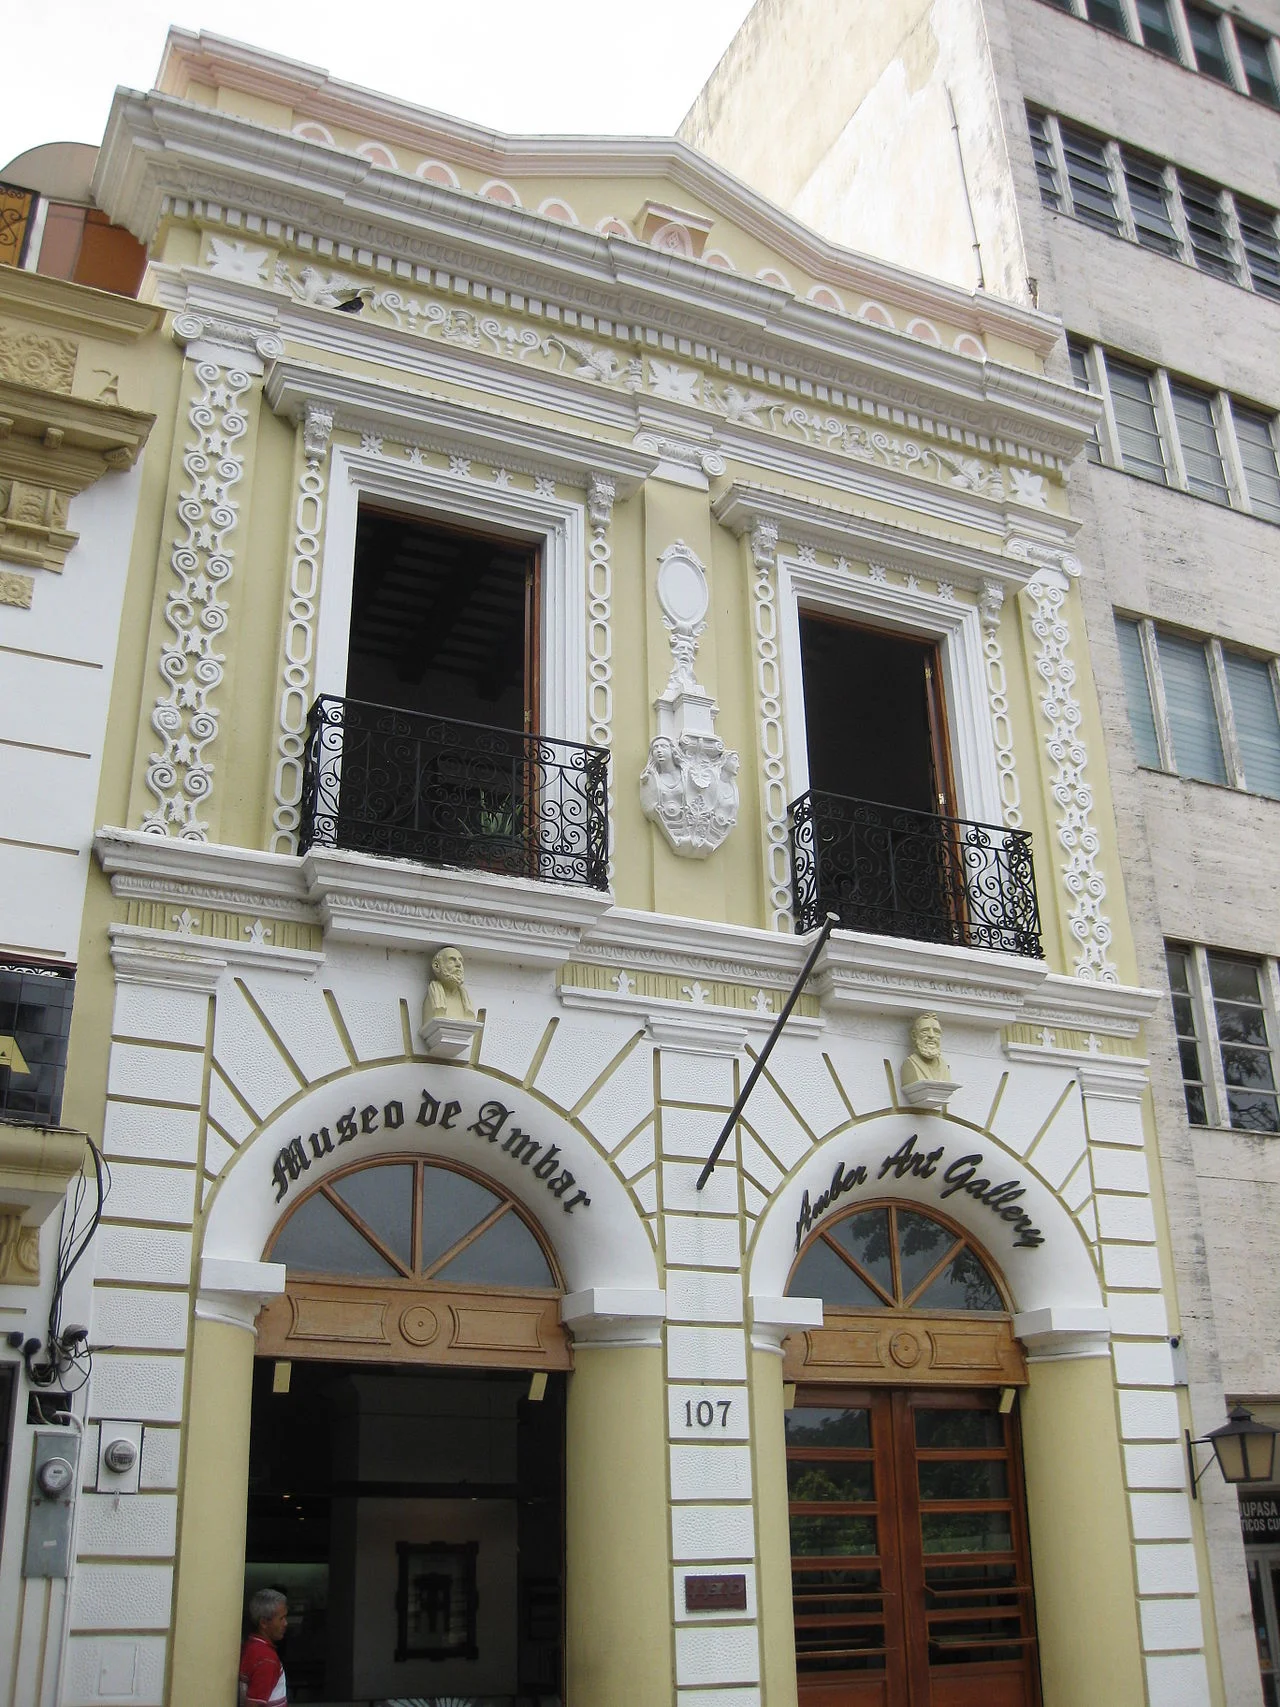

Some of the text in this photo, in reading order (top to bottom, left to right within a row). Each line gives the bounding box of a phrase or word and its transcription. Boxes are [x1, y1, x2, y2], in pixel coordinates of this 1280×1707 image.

[271, 1088, 591, 1214] Museo de Ambar
[794, 1133, 1045, 1253] Amber Art Gallery
[685, 1400, 732, 1428] 107
